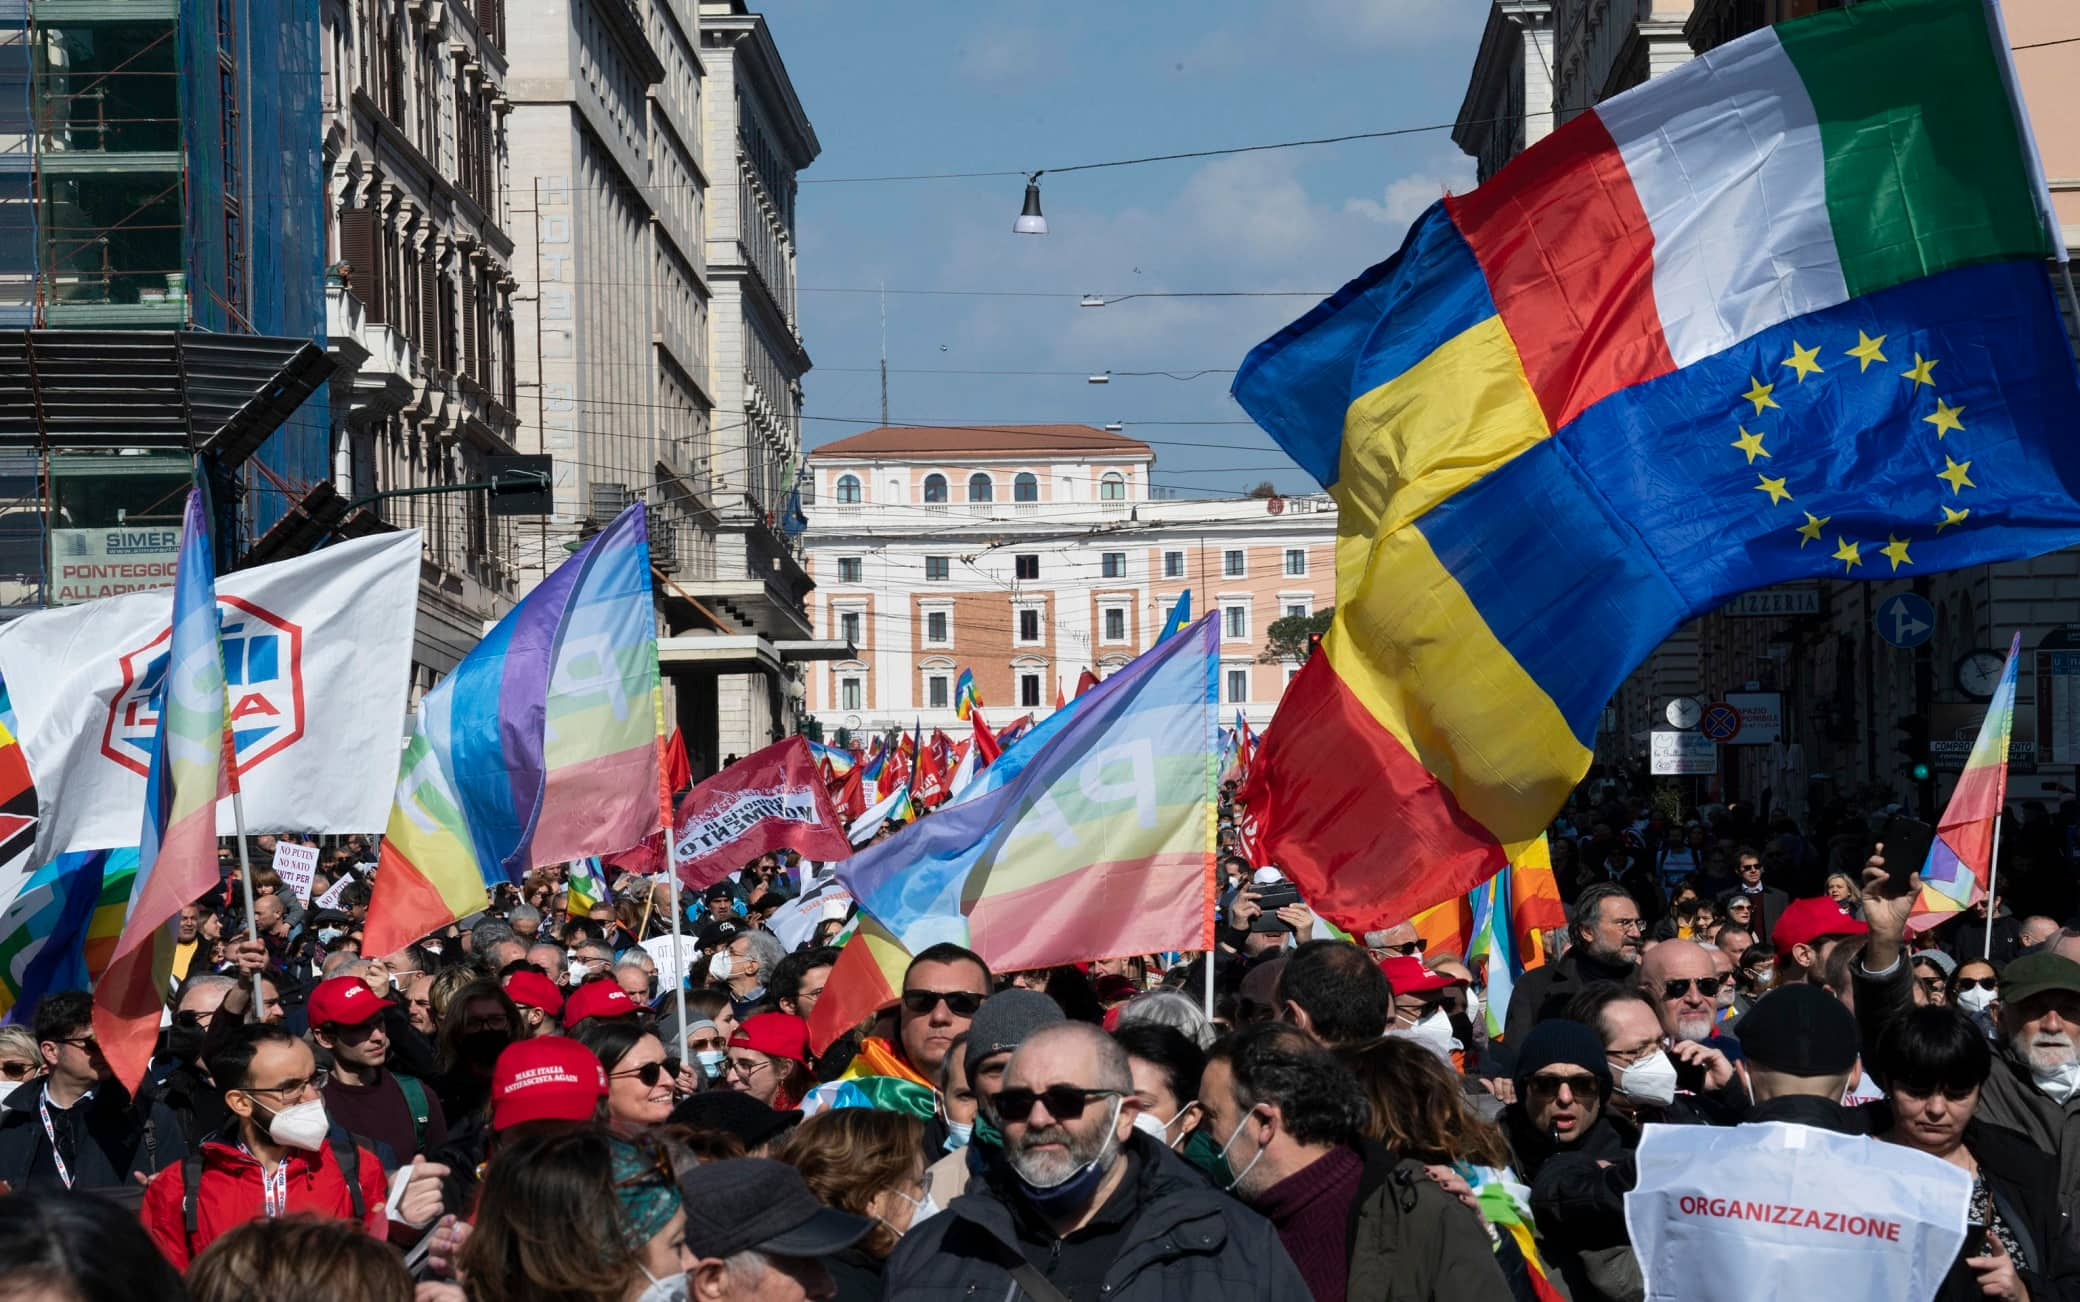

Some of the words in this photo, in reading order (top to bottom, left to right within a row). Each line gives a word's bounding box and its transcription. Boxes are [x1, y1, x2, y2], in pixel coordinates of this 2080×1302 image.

[106, 532, 176, 547] SIMER
[280, 845, 291, 855] NO
[292, 848, 314, 860] PUTIN
[279, 858, 290, 867] NO
[292, 861, 310, 871] NATO
[296, 874, 310, 884] PER
[288, 884, 304, 895] ACE
[515, 1069, 535, 1081] MAKE
[537, 1065, 564, 1075] ITALIA
[504, 1075, 553, 1094] ANTIFASCISTA
[553, 1073, 578, 1083] AGAIN
[1679, 1195, 1902, 1242] ORGANIZZAZIONE
